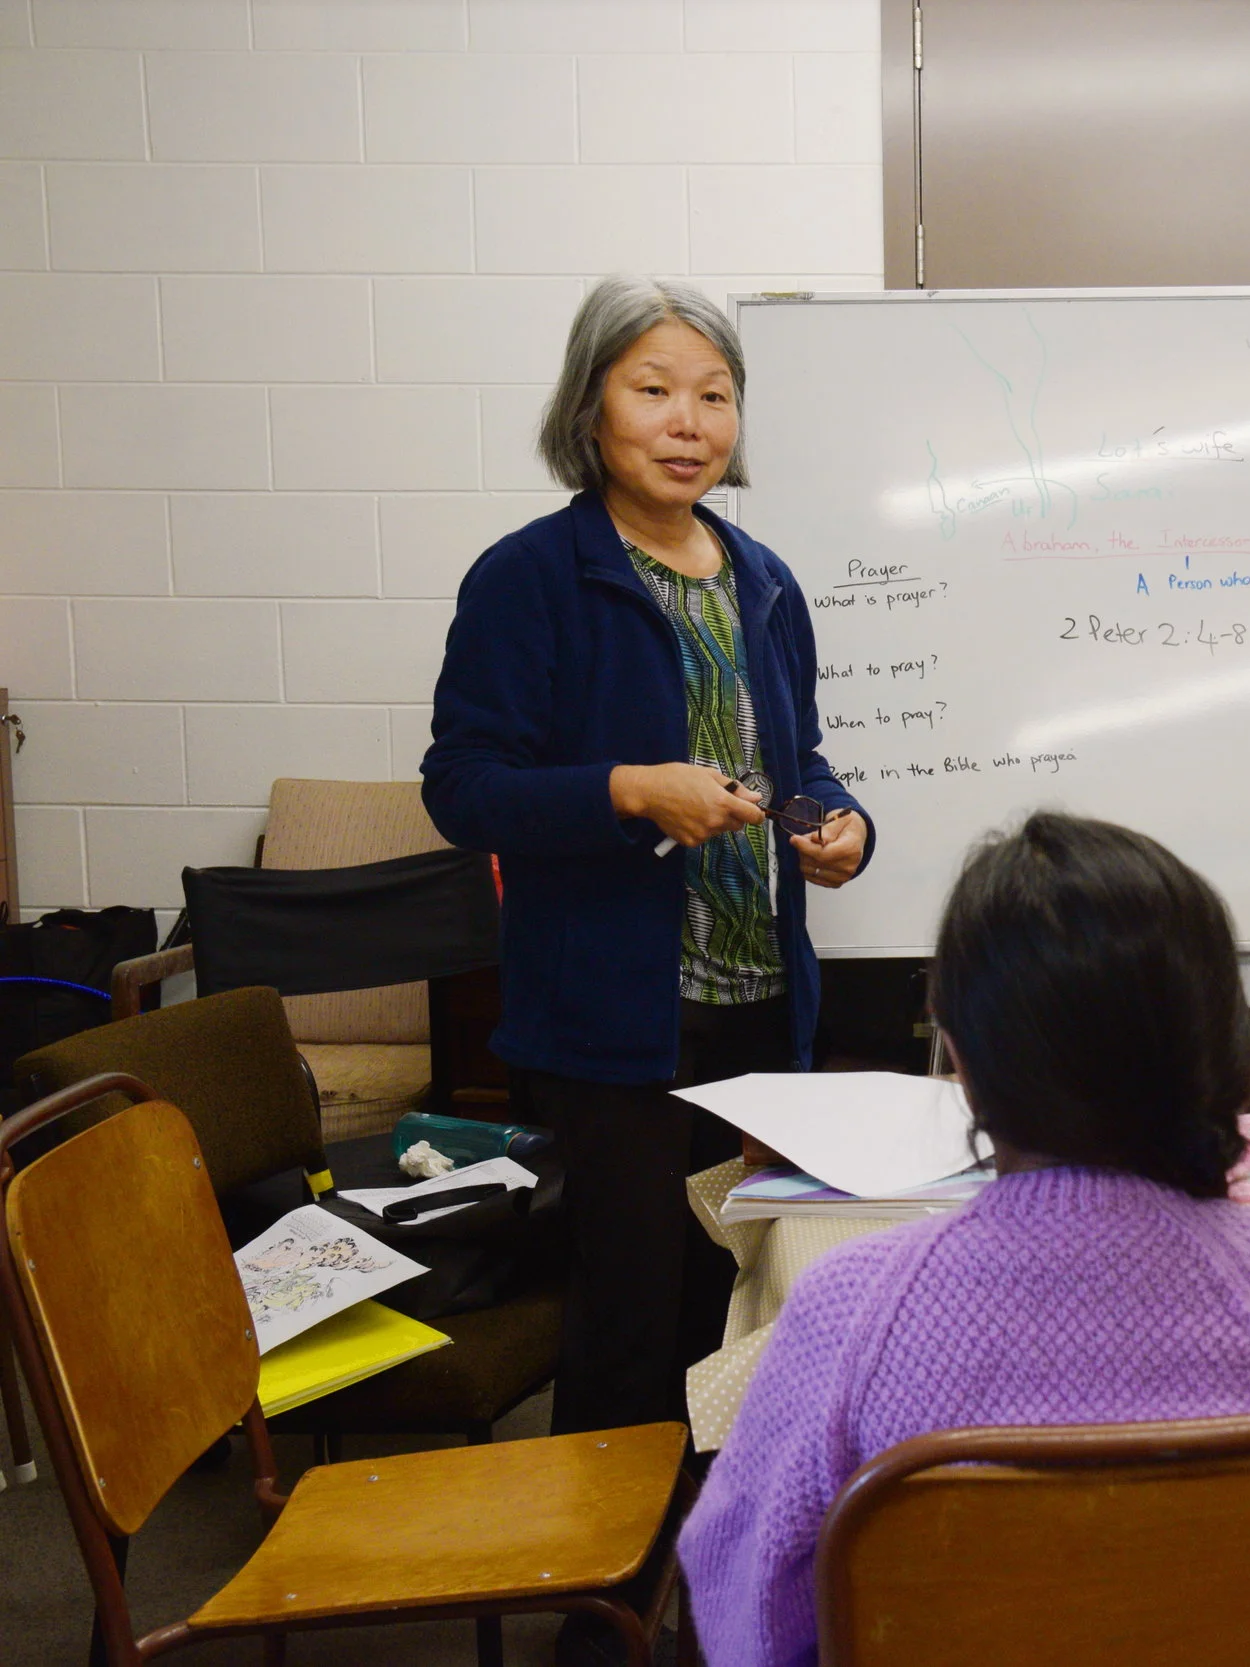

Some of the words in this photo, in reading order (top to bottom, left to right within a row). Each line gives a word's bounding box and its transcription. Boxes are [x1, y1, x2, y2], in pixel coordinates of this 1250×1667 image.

[1180, 430, 1239, 459] wife
[847, 558, 908, 586] Prayer
[1137, 573, 1150, 597] A
[864, 594, 877, 606] is
[1059, 617, 1080, 641] 2
[1088, 614, 1148, 646] Peter
[818, 663, 855, 681] What
[867, 662, 880, 677] to
[826, 715, 866, 731] When
[875, 708, 891, 726] to
[880, 764, 901, 780] in
[906, 762, 935, 778] the
[943, 756, 982, 774] Bible
[992, 752, 1021, 768] who
